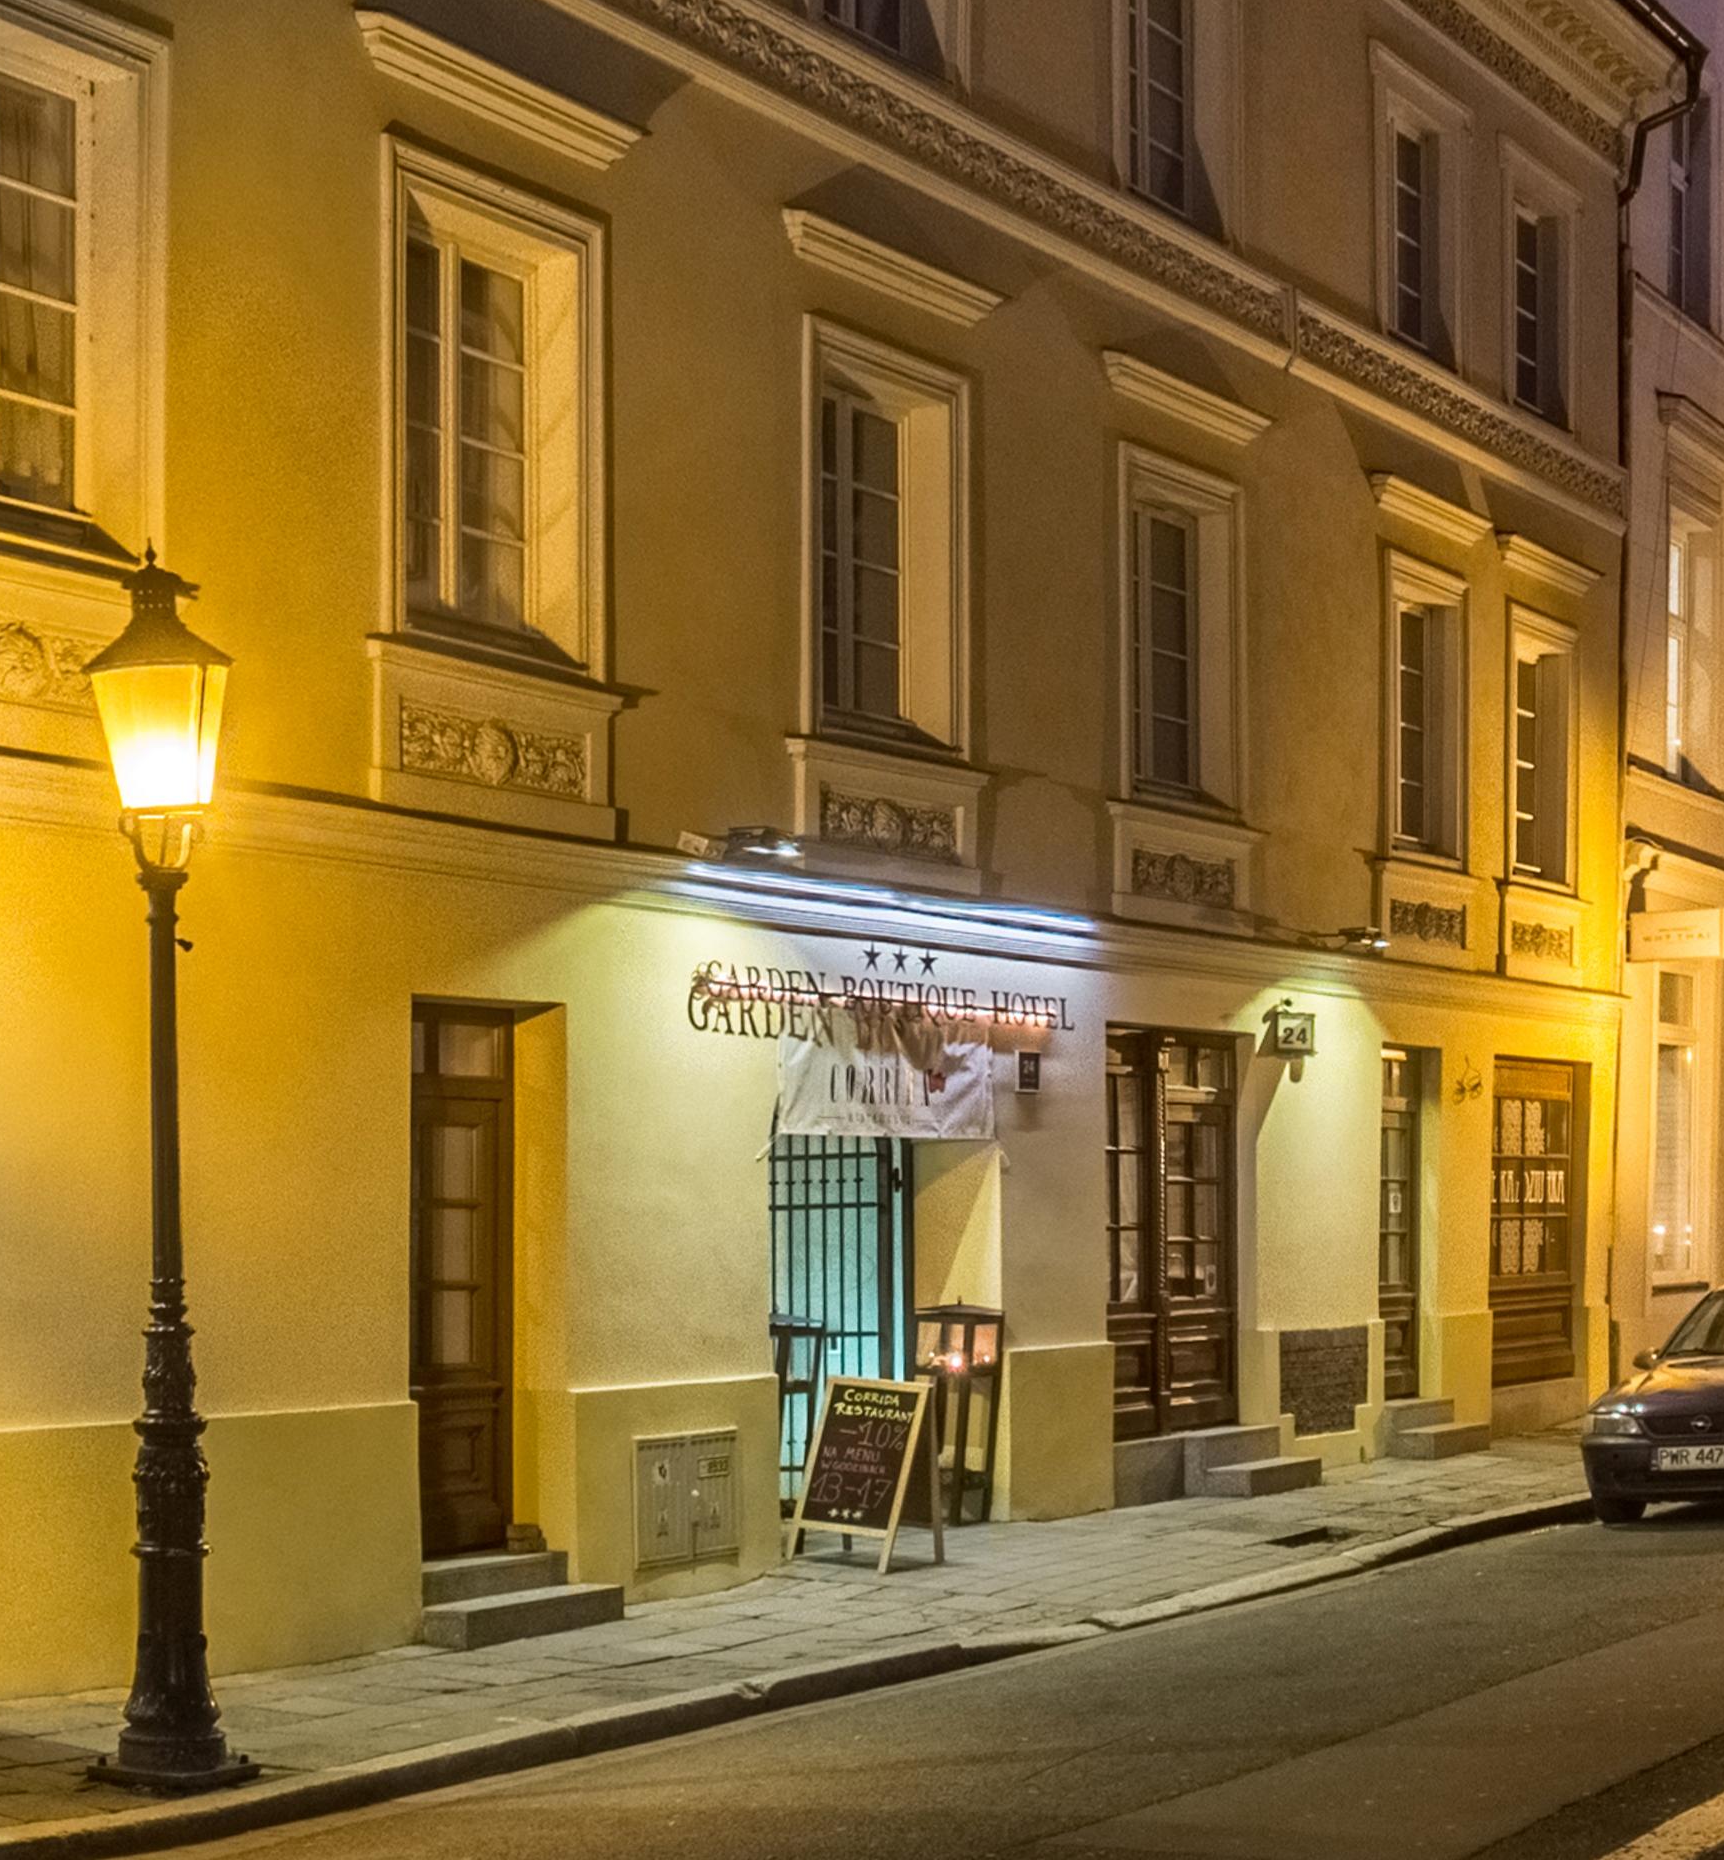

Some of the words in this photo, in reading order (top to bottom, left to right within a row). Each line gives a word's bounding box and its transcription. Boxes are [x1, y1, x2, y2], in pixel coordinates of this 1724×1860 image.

[706, 960, 827, 1008] GARDEN
[841, 976, 976, 1026] BOUTIQUE
[991, 990, 1075, 1031] HOTEL
[1281, 1026, 1308, 1045] 24
[843, 1388, 900, 1407] CORRIDA
[833, 1401, 915, 1424] RESTAURANT
[823, 1445, 837, 1458] NA
[843, 1446, 881, 1463] MENU
[1660, 1448, 1690, 1466] PWR
